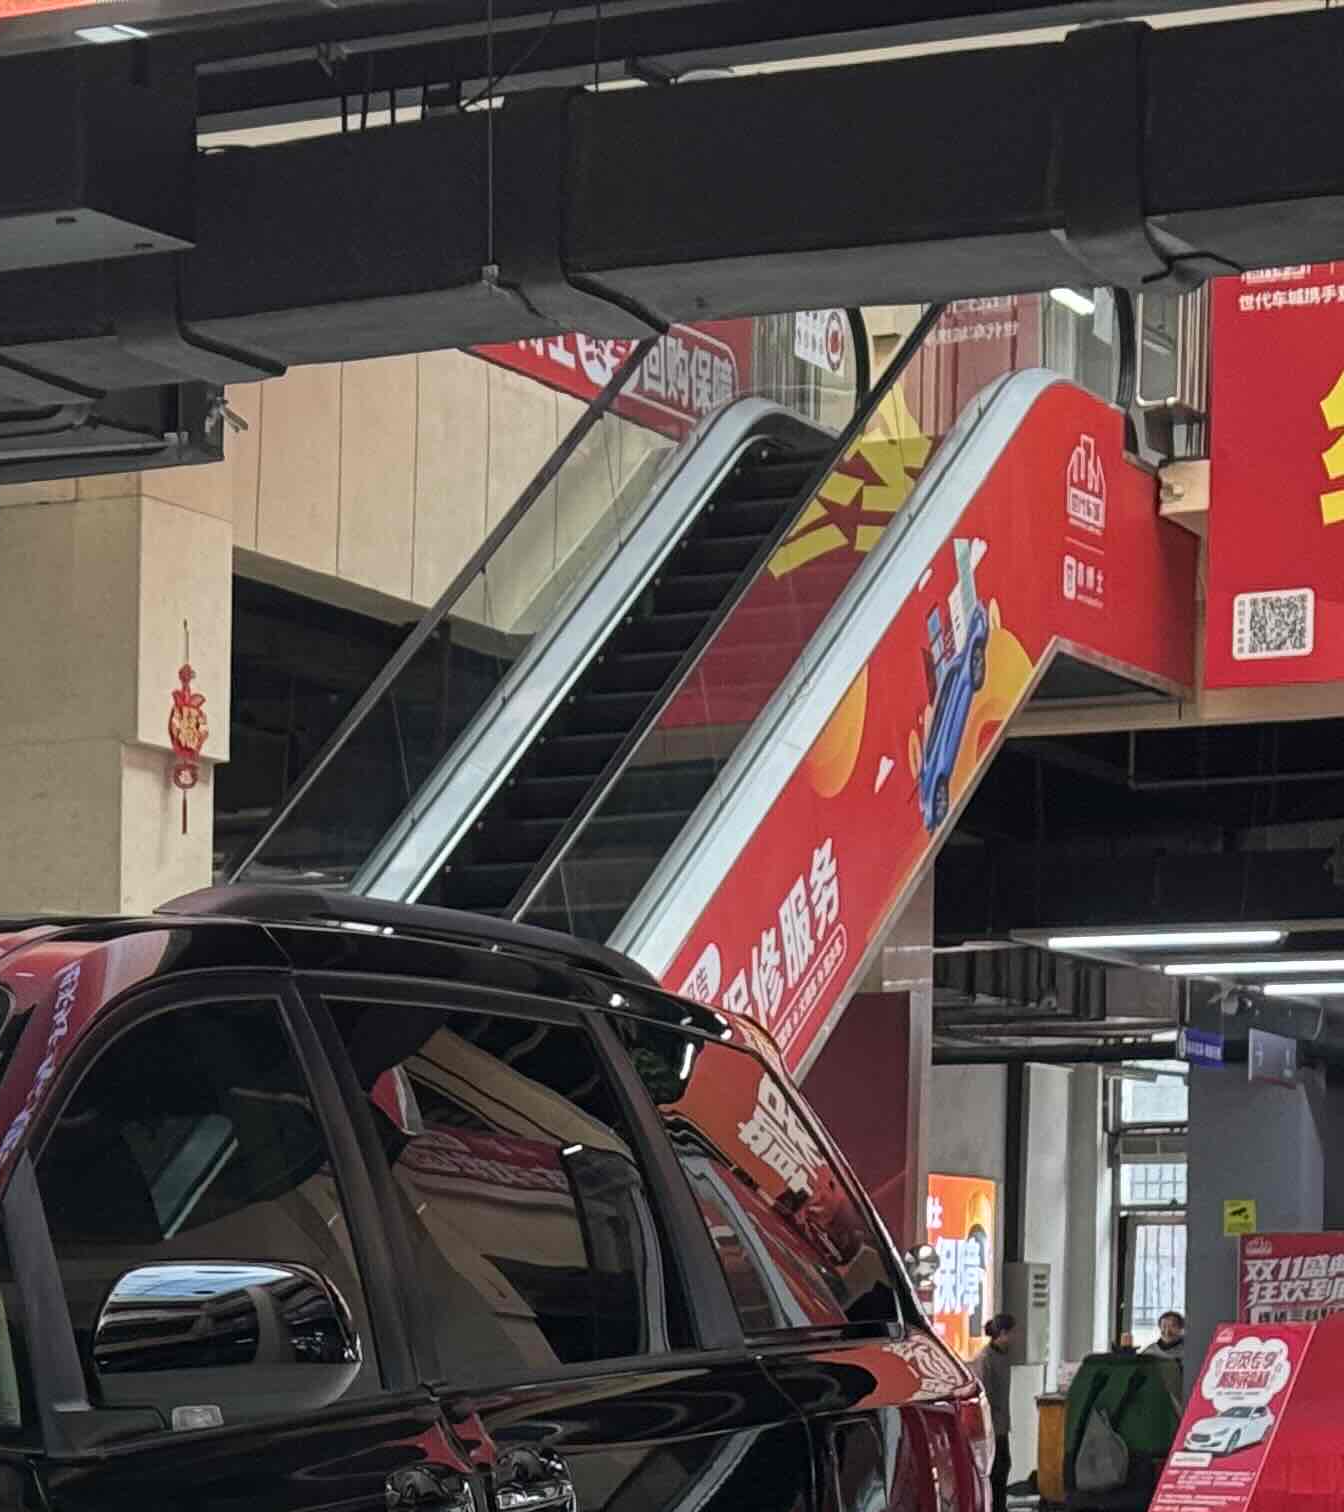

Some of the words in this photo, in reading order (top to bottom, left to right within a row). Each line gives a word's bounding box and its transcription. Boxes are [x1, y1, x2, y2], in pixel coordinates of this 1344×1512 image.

[1238, 284, 1344, 312] 世代车城携手
